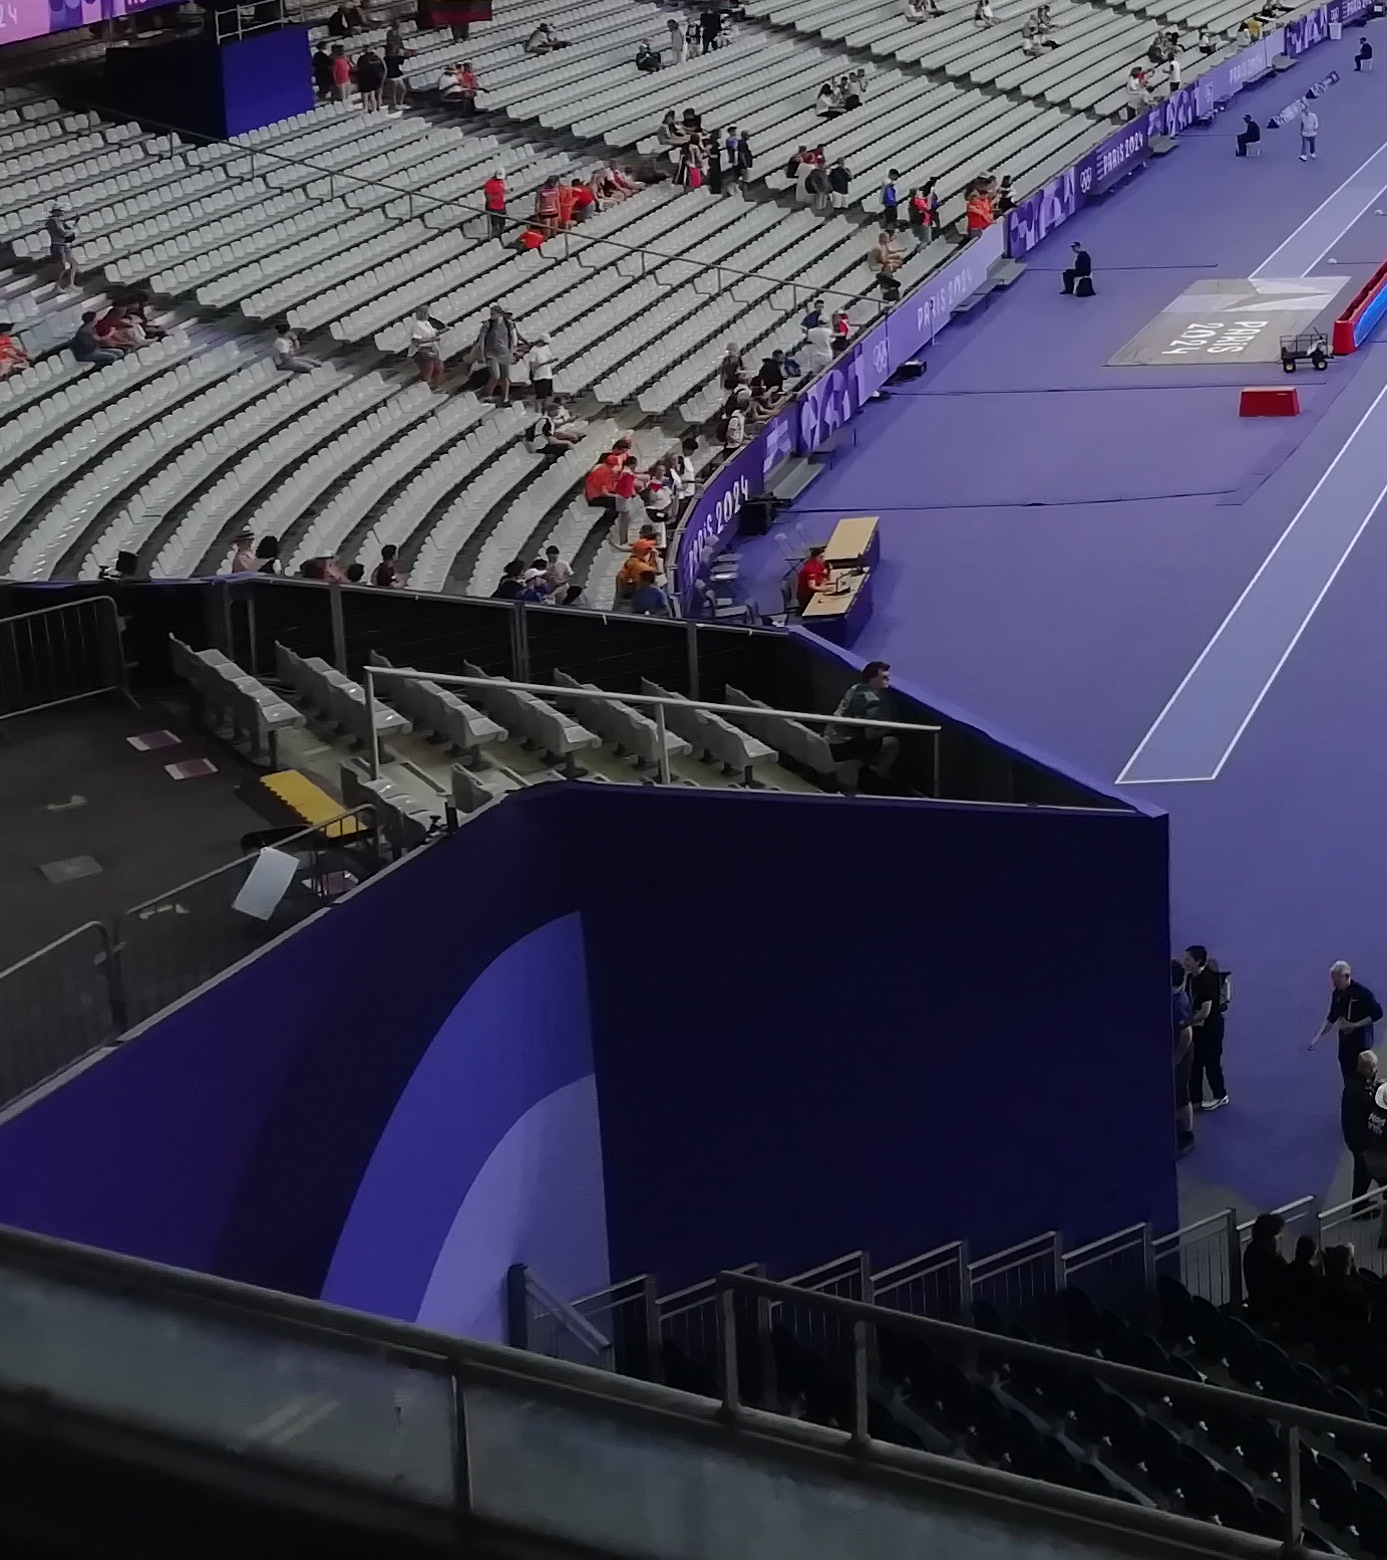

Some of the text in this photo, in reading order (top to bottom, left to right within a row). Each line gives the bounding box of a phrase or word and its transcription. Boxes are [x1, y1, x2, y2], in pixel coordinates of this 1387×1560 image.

[1103, 130, 1143, 175] PARIS 2024
[917, 266, 972, 331] PARIS 2024
[1161, 321, 1268, 354] PARIS 2024
[715, 474, 749, 535] 2024
